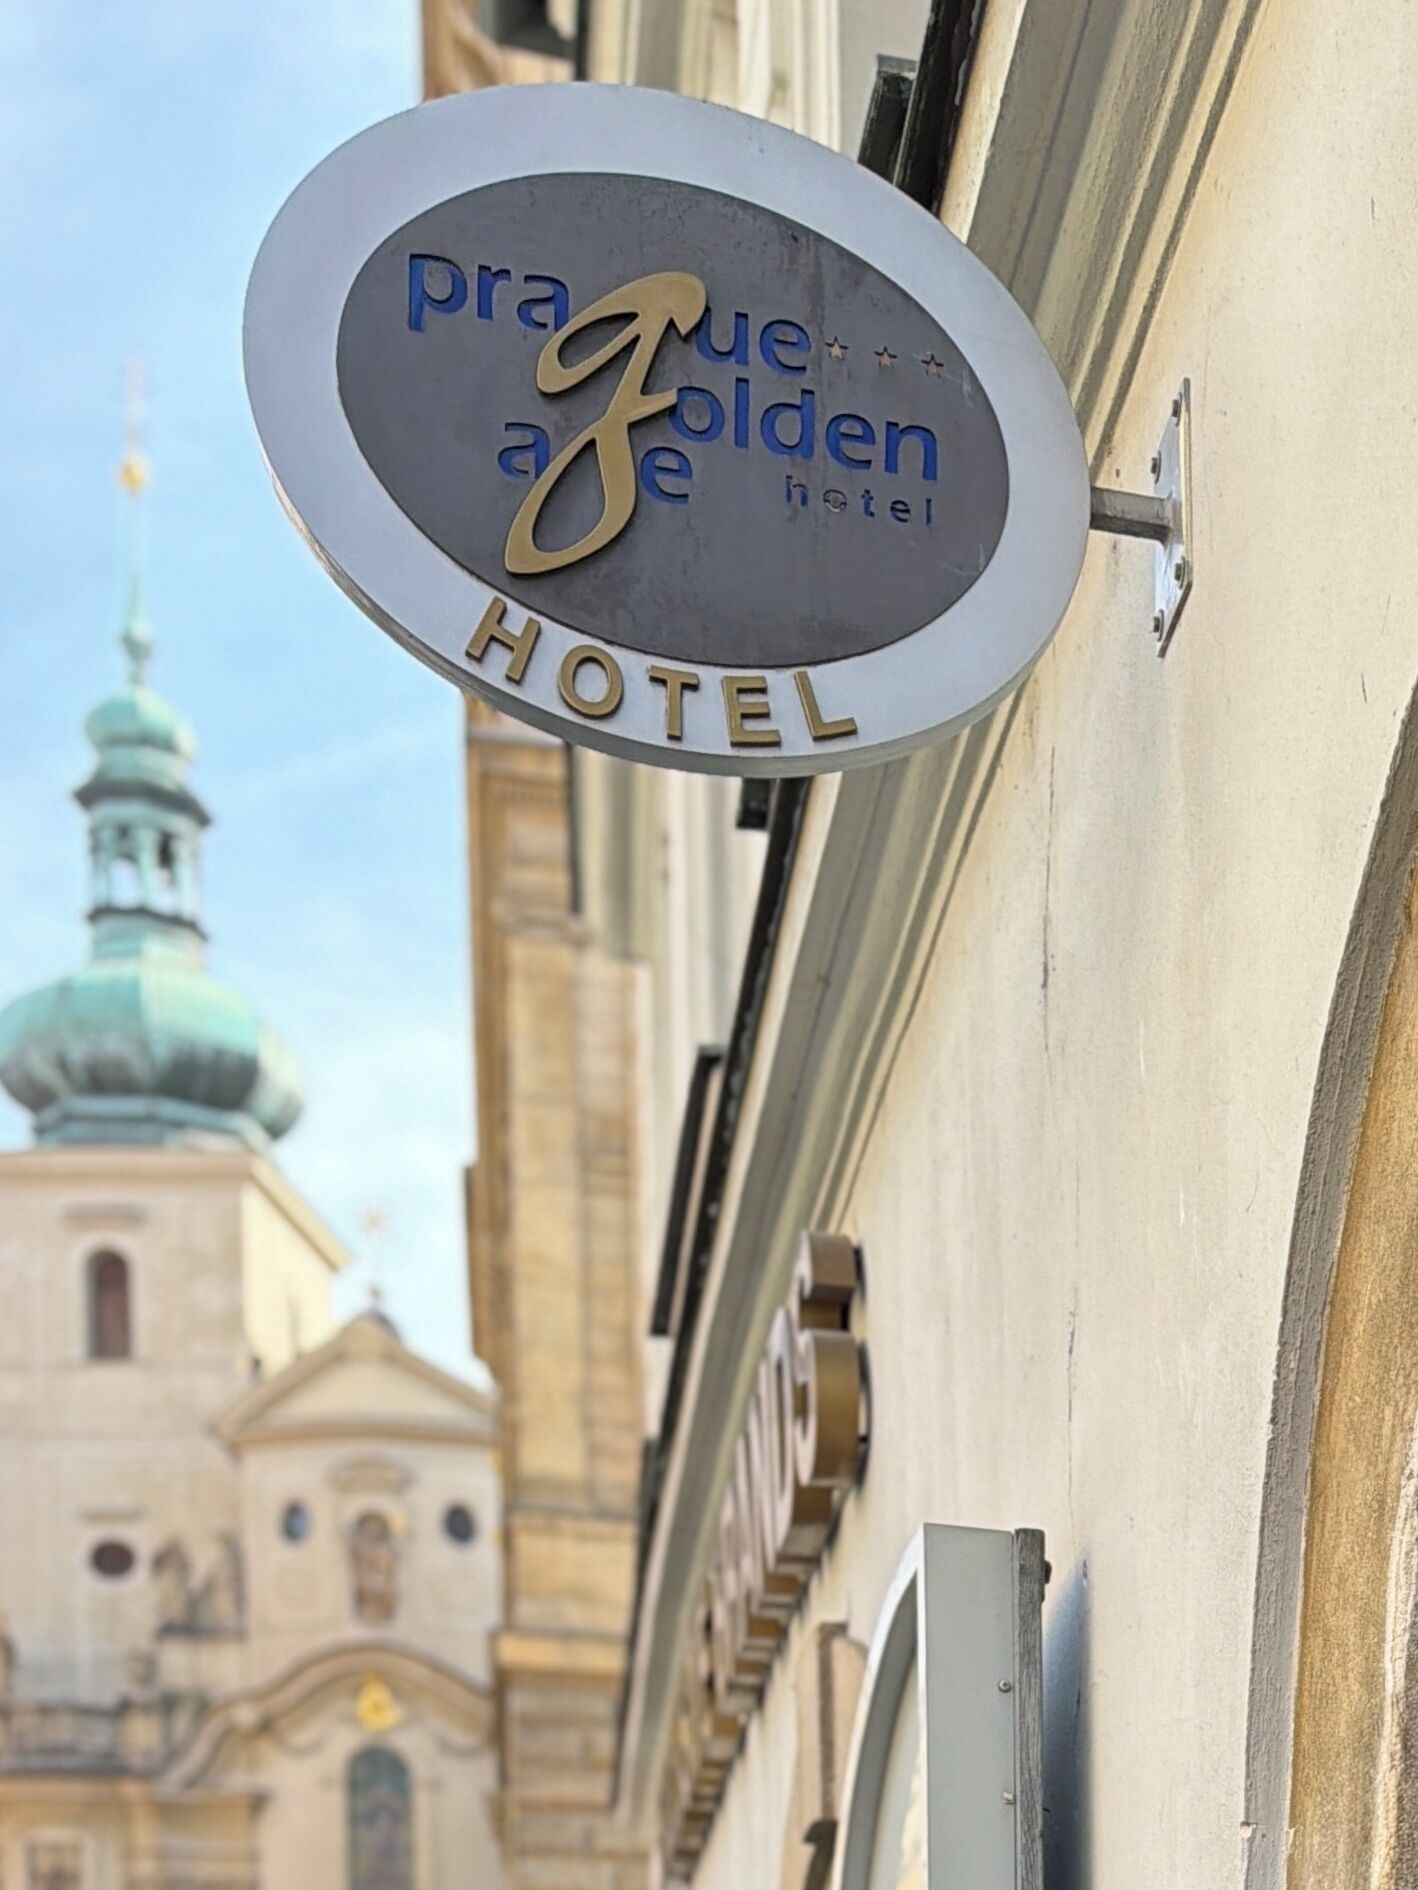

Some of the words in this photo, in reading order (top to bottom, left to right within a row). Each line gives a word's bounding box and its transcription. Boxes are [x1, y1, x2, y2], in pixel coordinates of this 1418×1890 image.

[407, 252, 812, 394] prague
[498, 421, 693, 575] age
[785, 474, 933, 526] hotel
[465, 596, 858, 748] HOTEL
